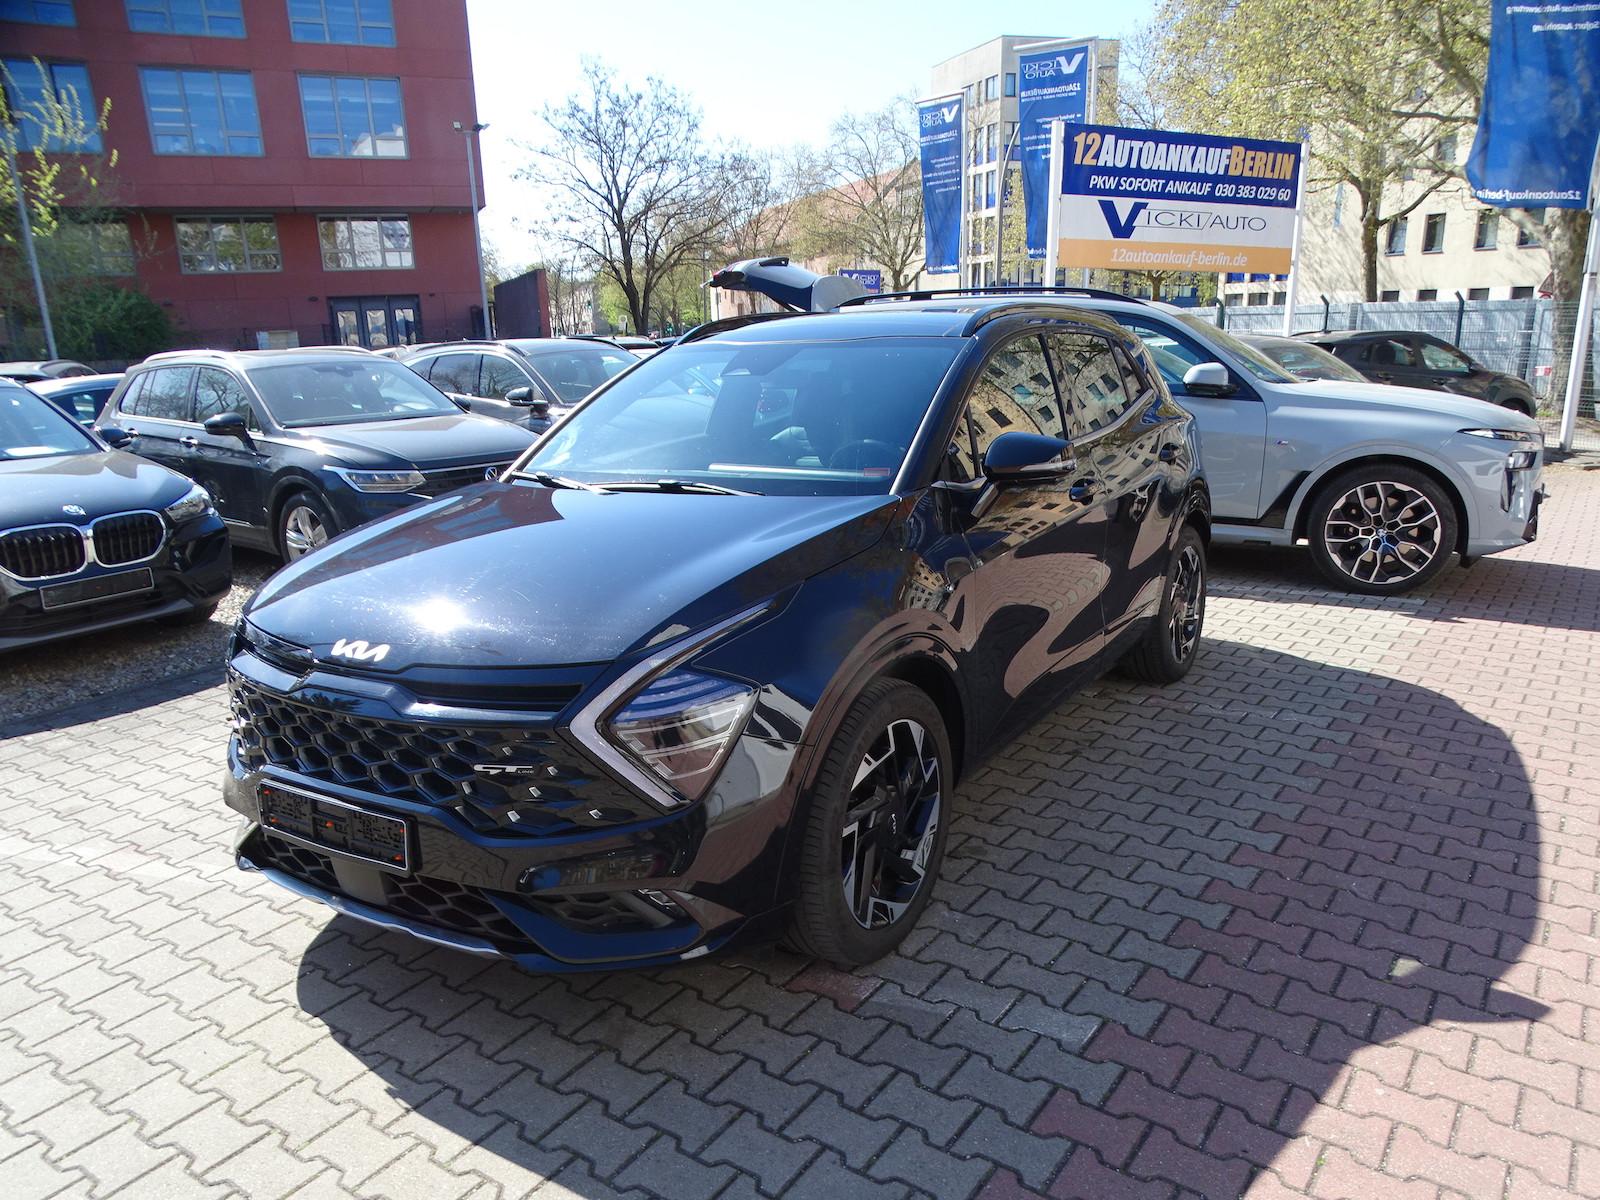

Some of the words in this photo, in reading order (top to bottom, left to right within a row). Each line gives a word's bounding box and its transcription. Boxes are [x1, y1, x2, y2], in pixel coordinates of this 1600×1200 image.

[1089, 175, 1119, 190] PKW
[1119, 176, 1165, 192] SOFORT
[1165, 180, 1213, 196] ANKAUF
[1214, 183, 1236, 197] 030
[1236, 184, 1256, 199] 383
[1257, 186, 1277, 200] 029
[1277, 188, 1291, 201] 60
[1110, 247, 1248, 268] 12autoankauf-berlin.de
[331, 638, 390, 662] KIA
